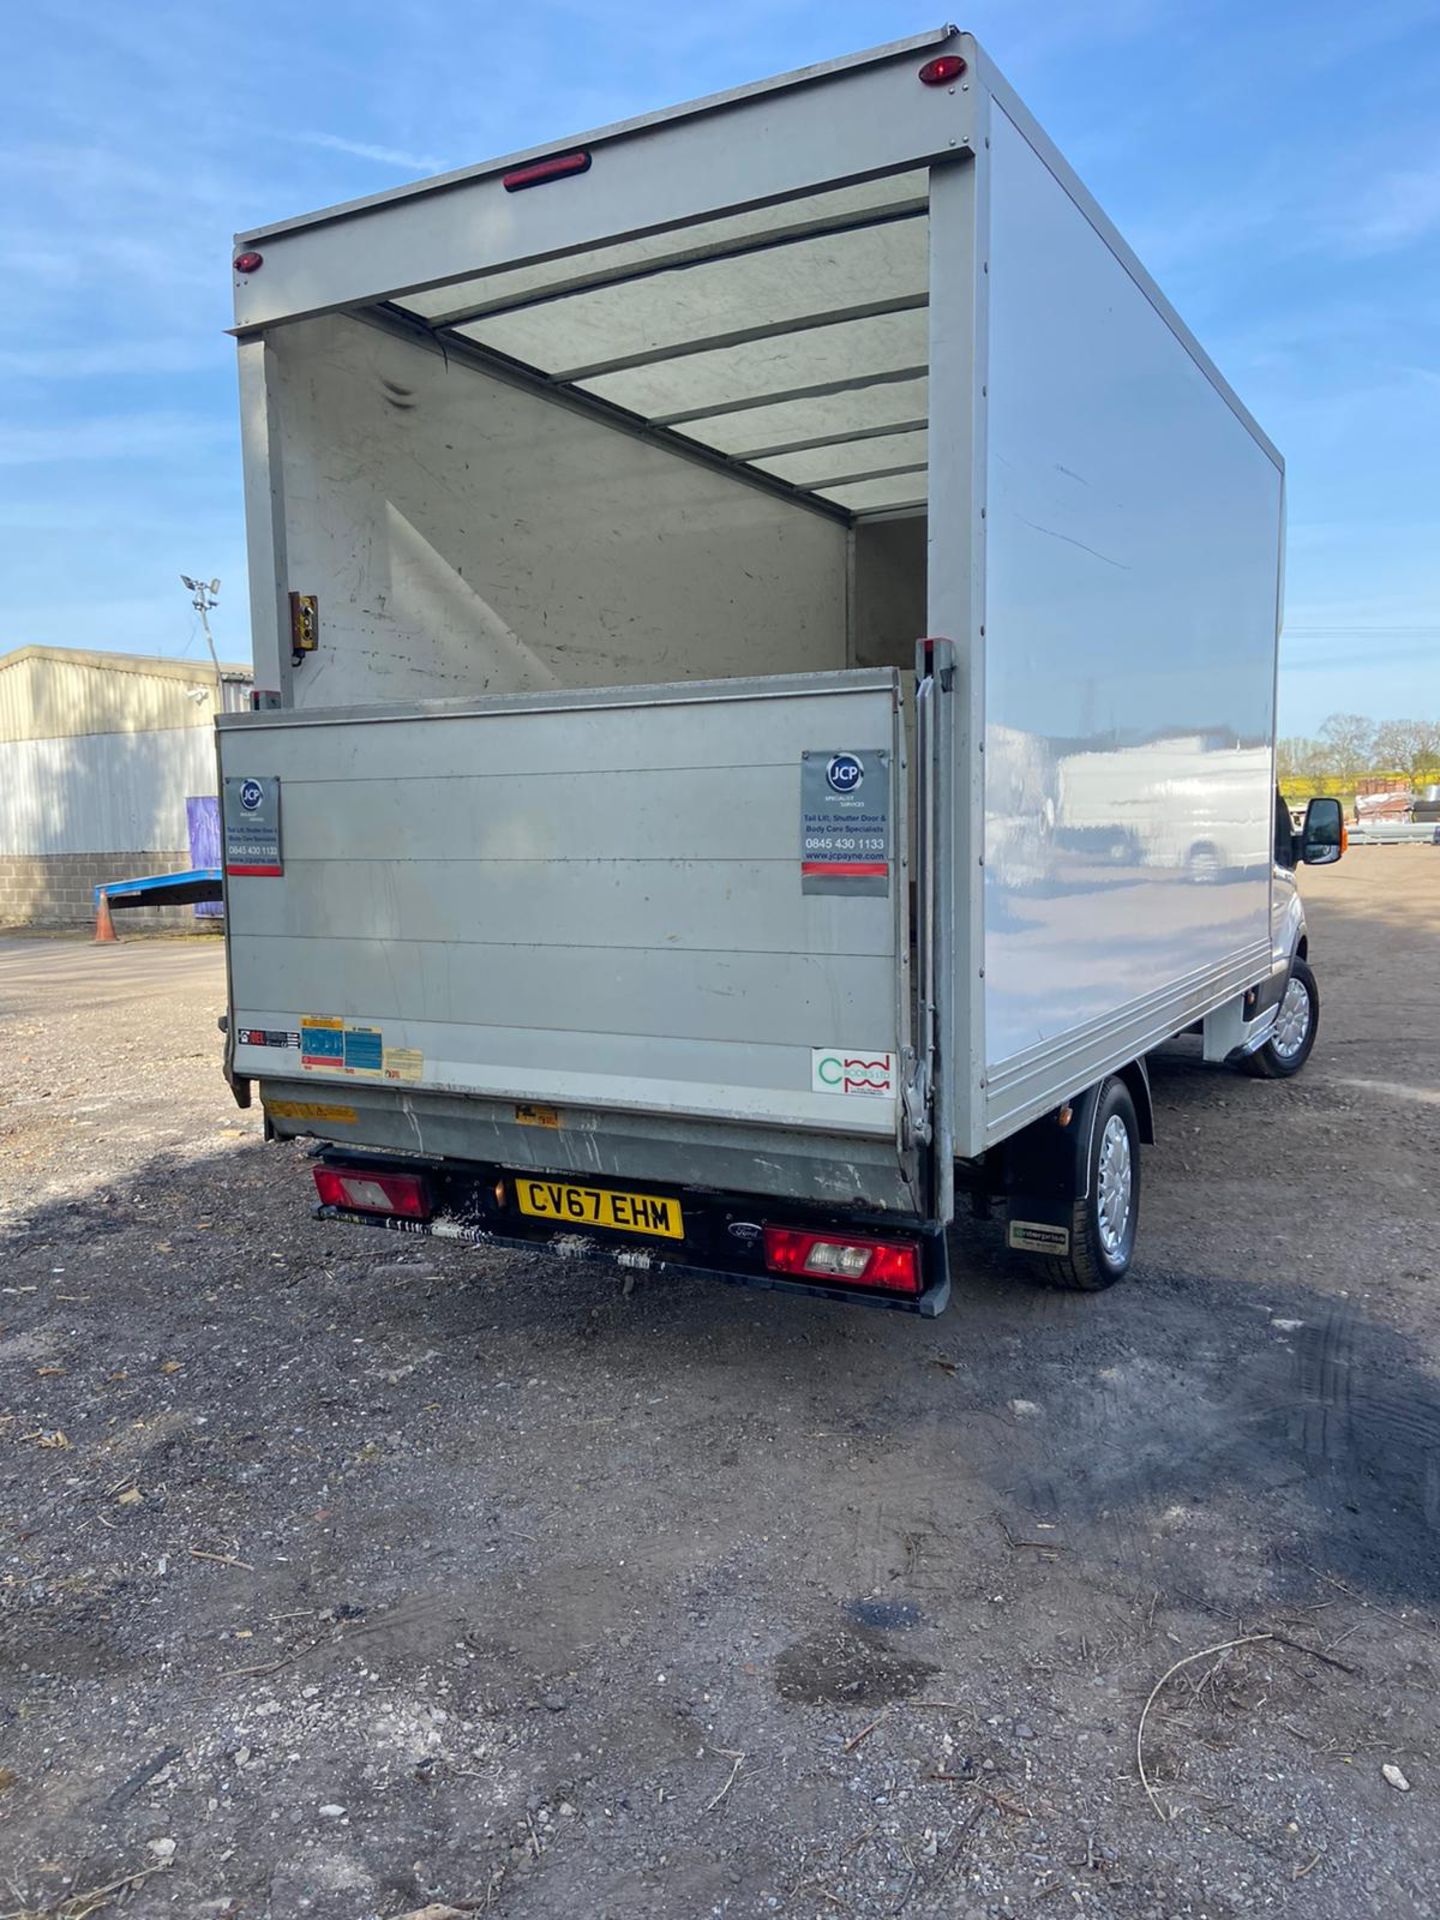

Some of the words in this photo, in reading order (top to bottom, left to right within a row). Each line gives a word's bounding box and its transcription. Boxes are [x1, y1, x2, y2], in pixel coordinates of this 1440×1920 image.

[832, 766, 858, 780] JCP
[244, 788, 260, 800] JCP
[806, 825, 824, 834] Body
[826, 825, 843, 833] Care
[845, 825, 884, 834] Specialists
[805, 838, 833, 849] 0845
[835, 838, 855, 849] 430
[860, 838, 884, 849] 1133
[806, 851, 884, 861] www.jcpayne.com
[529, 1183, 601, 1220] CV67
[611, 1194, 671, 1232] EHM
